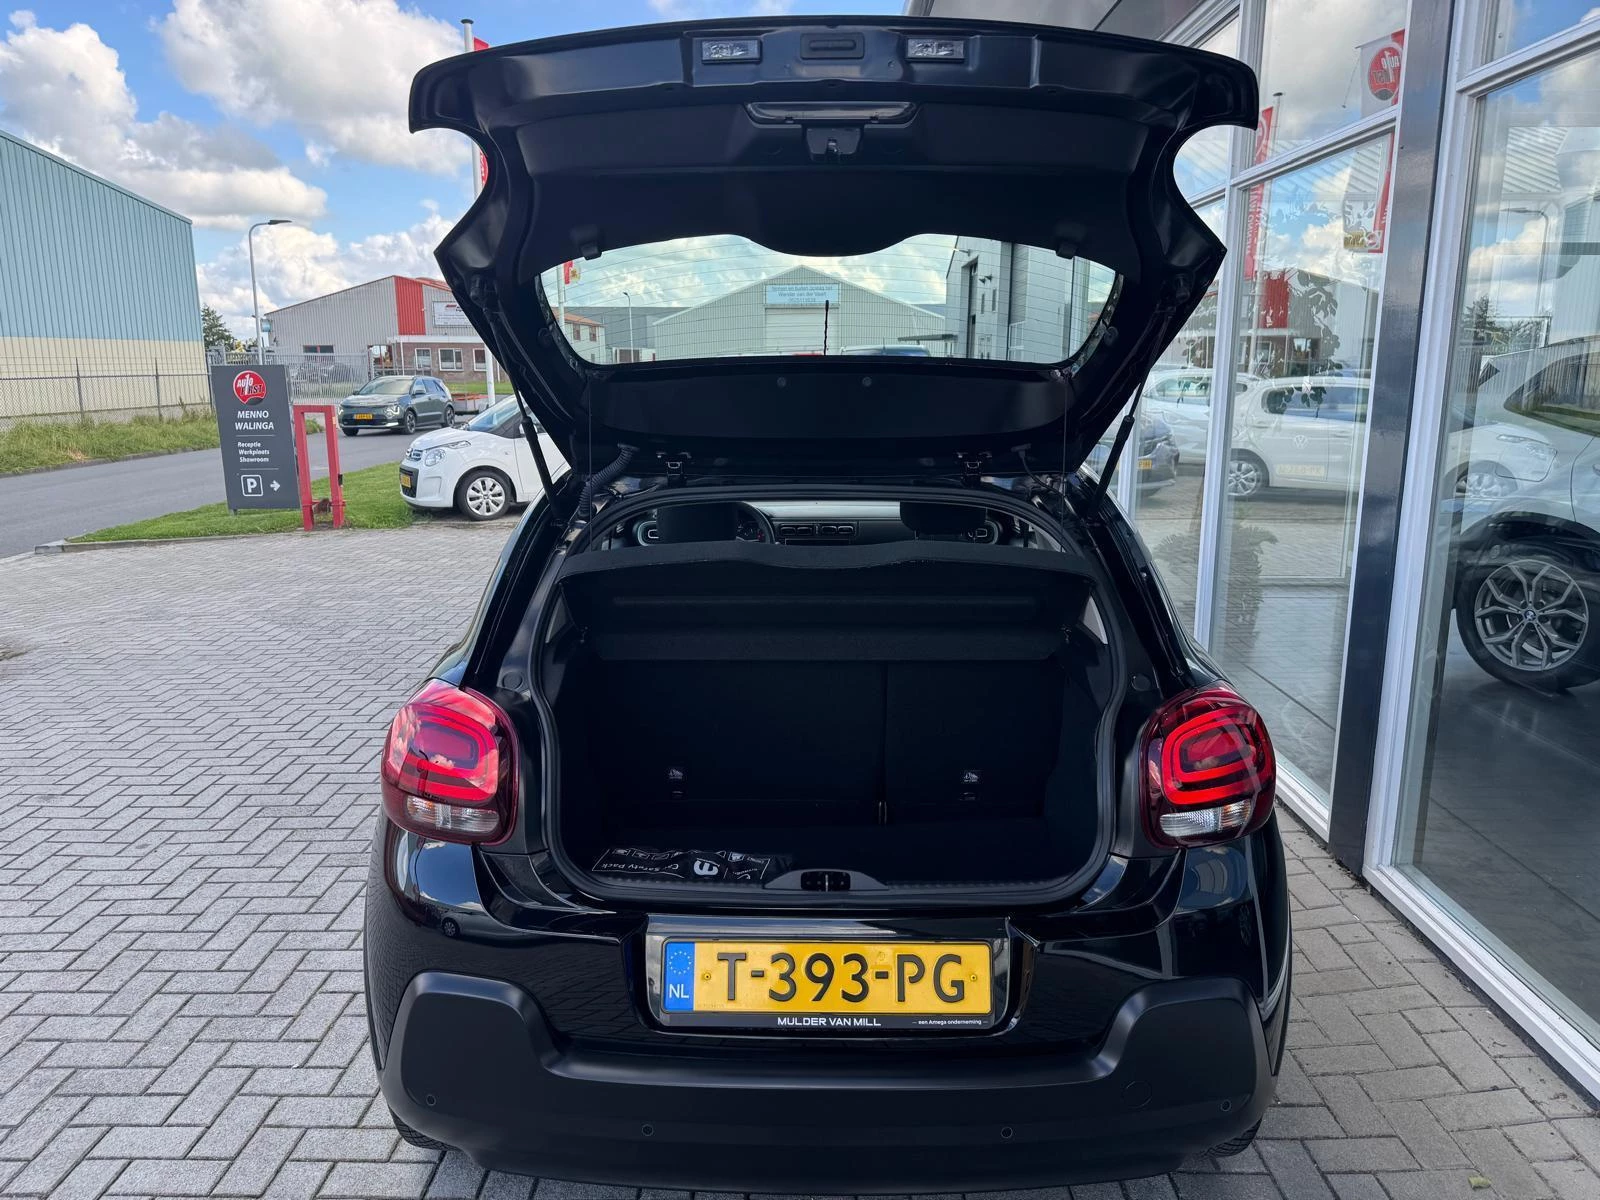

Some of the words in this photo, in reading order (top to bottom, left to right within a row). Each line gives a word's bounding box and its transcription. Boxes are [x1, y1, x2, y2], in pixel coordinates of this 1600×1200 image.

[237, 410, 269, 419] MENNO
[235, 422, 274, 431] WALINGA
[246, 478, 257, 493] P
[668, 984, 690, 999] NL
[716, 951, 966, 1003] T-393-PG
[777, 1016, 827, 1026] MULDER
[828, 1016, 851, 1026] VAN
[853, 1017, 881, 1027] MILL
[947, 1018, 982, 1026] onderneming
